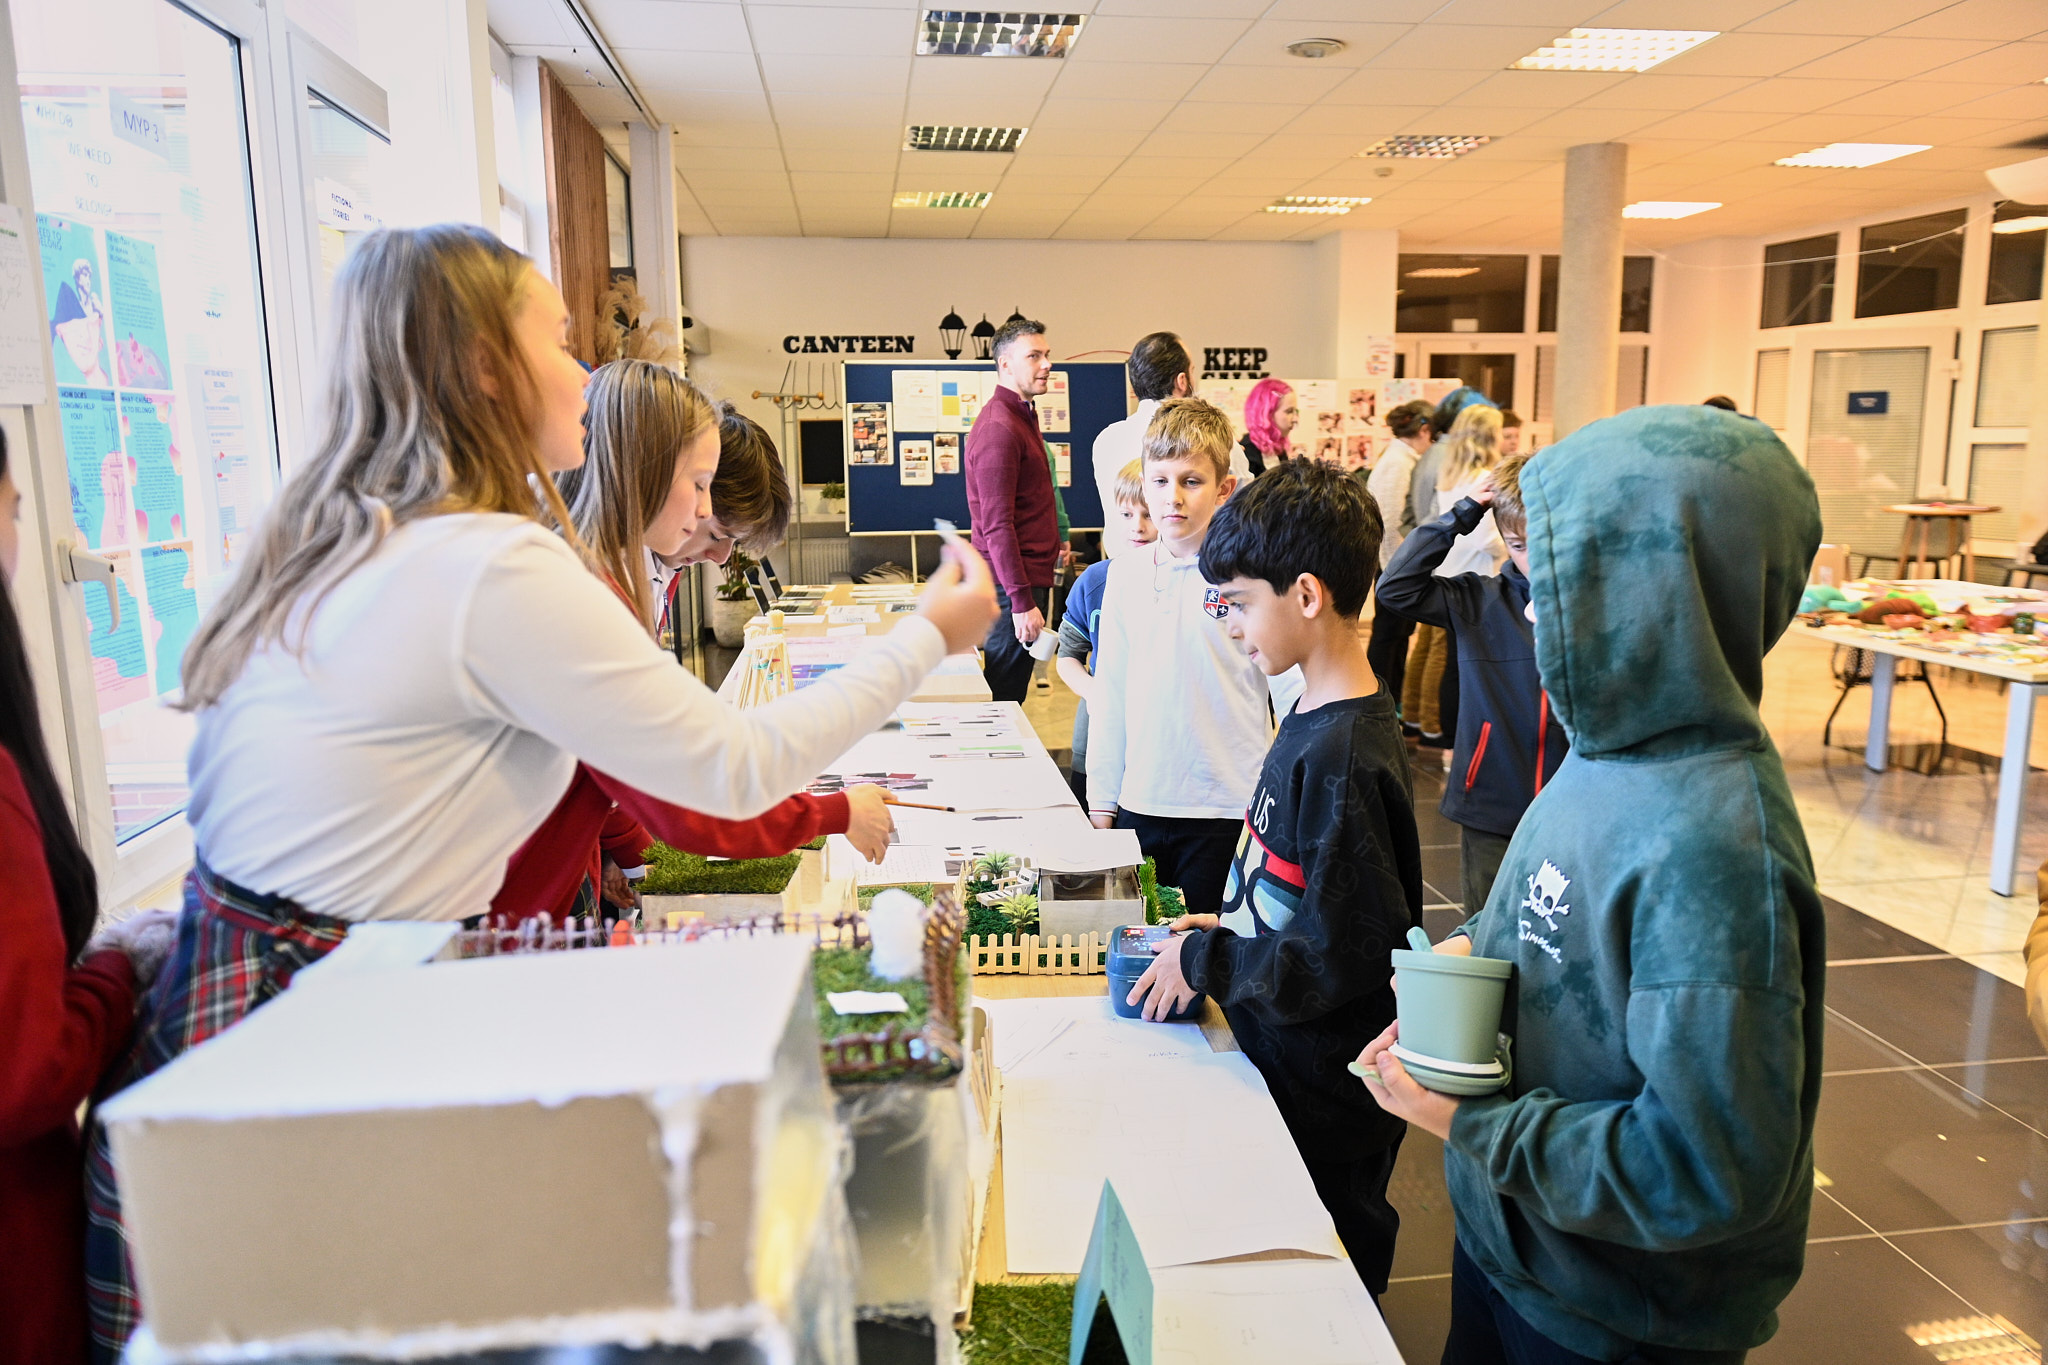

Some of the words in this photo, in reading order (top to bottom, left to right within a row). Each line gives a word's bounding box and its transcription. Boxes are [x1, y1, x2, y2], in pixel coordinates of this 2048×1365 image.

[123, 110, 149, 138] MYP
[152, 124, 160, 143] 3
[83, 146, 112, 166] NEED
[783, 335, 915, 353] CANTEEN
[1203, 347, 1268, 371] KEEP
